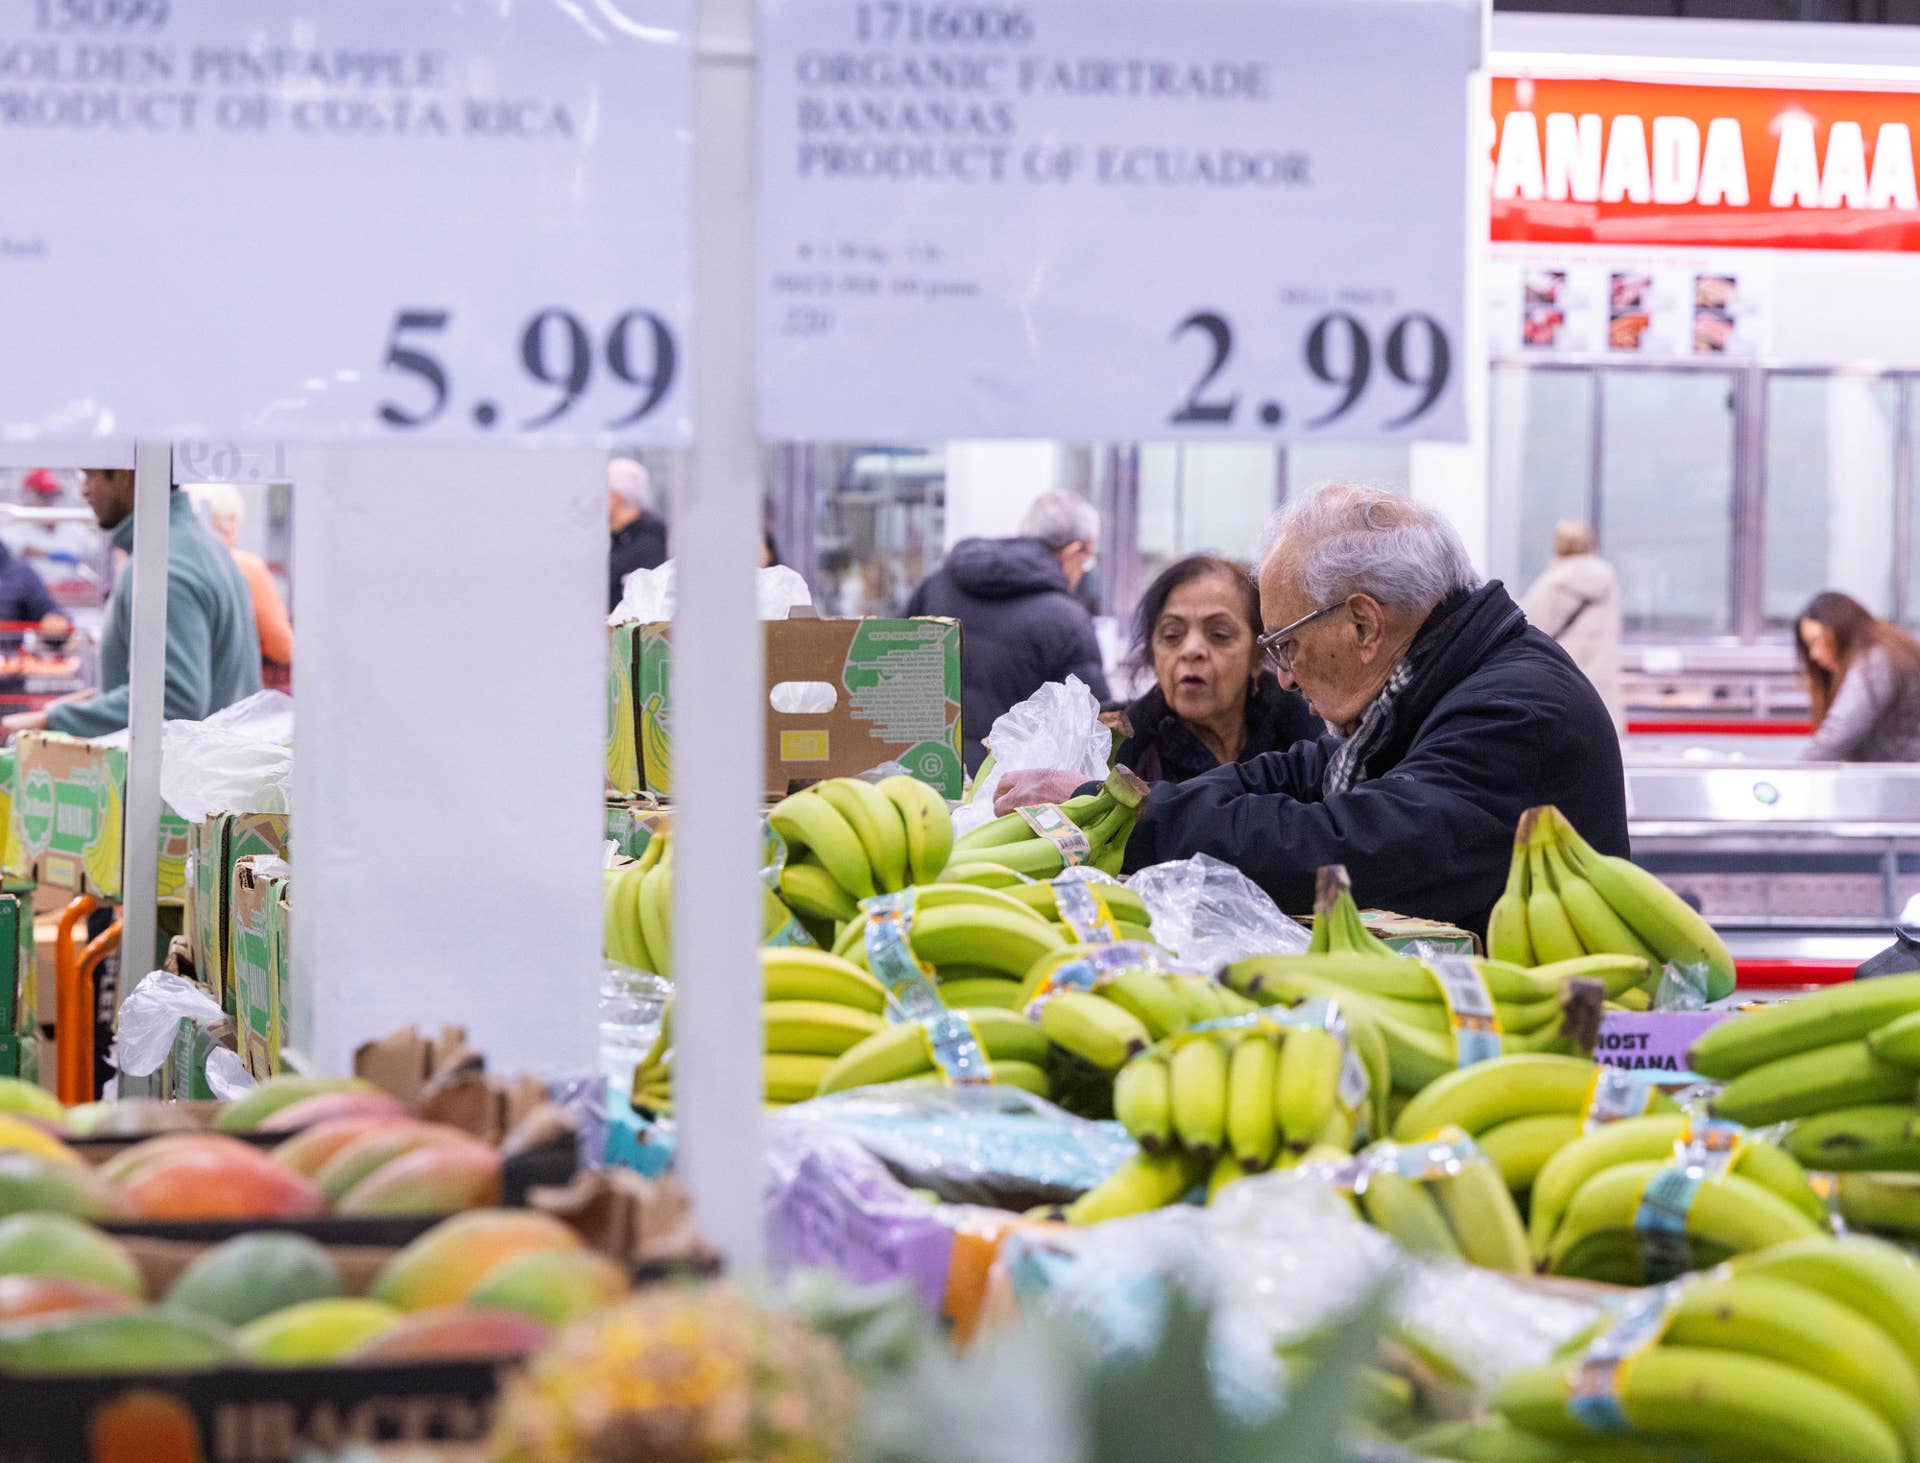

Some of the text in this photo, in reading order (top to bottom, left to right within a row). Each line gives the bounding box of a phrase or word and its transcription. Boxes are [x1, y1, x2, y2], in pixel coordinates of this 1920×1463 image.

[36, 0, 171, 34] 15099
[855, 0, 1034, 45] 1716006
[0, 43, 446, 88] OLDEN PINEAPPLE
[796, 52, 1270, 99] ORGANIC FAIRTRADE
[214, 93, 276, 133] OF
[290, 97, 450, 138] COSTA
[464, 99, 574, 139] RICA
[797, 98, 1016, 134] BANANAS
[797, 143, 1313, 188] PRODUCT OF ECUADOR
[1769, 118, 1919, 211] AAA
[376, 308, 677, 431] 5.99
[1168, 309, 1452, 430] 2.99
[1594, 1055, 1678, 1071] ANANA
